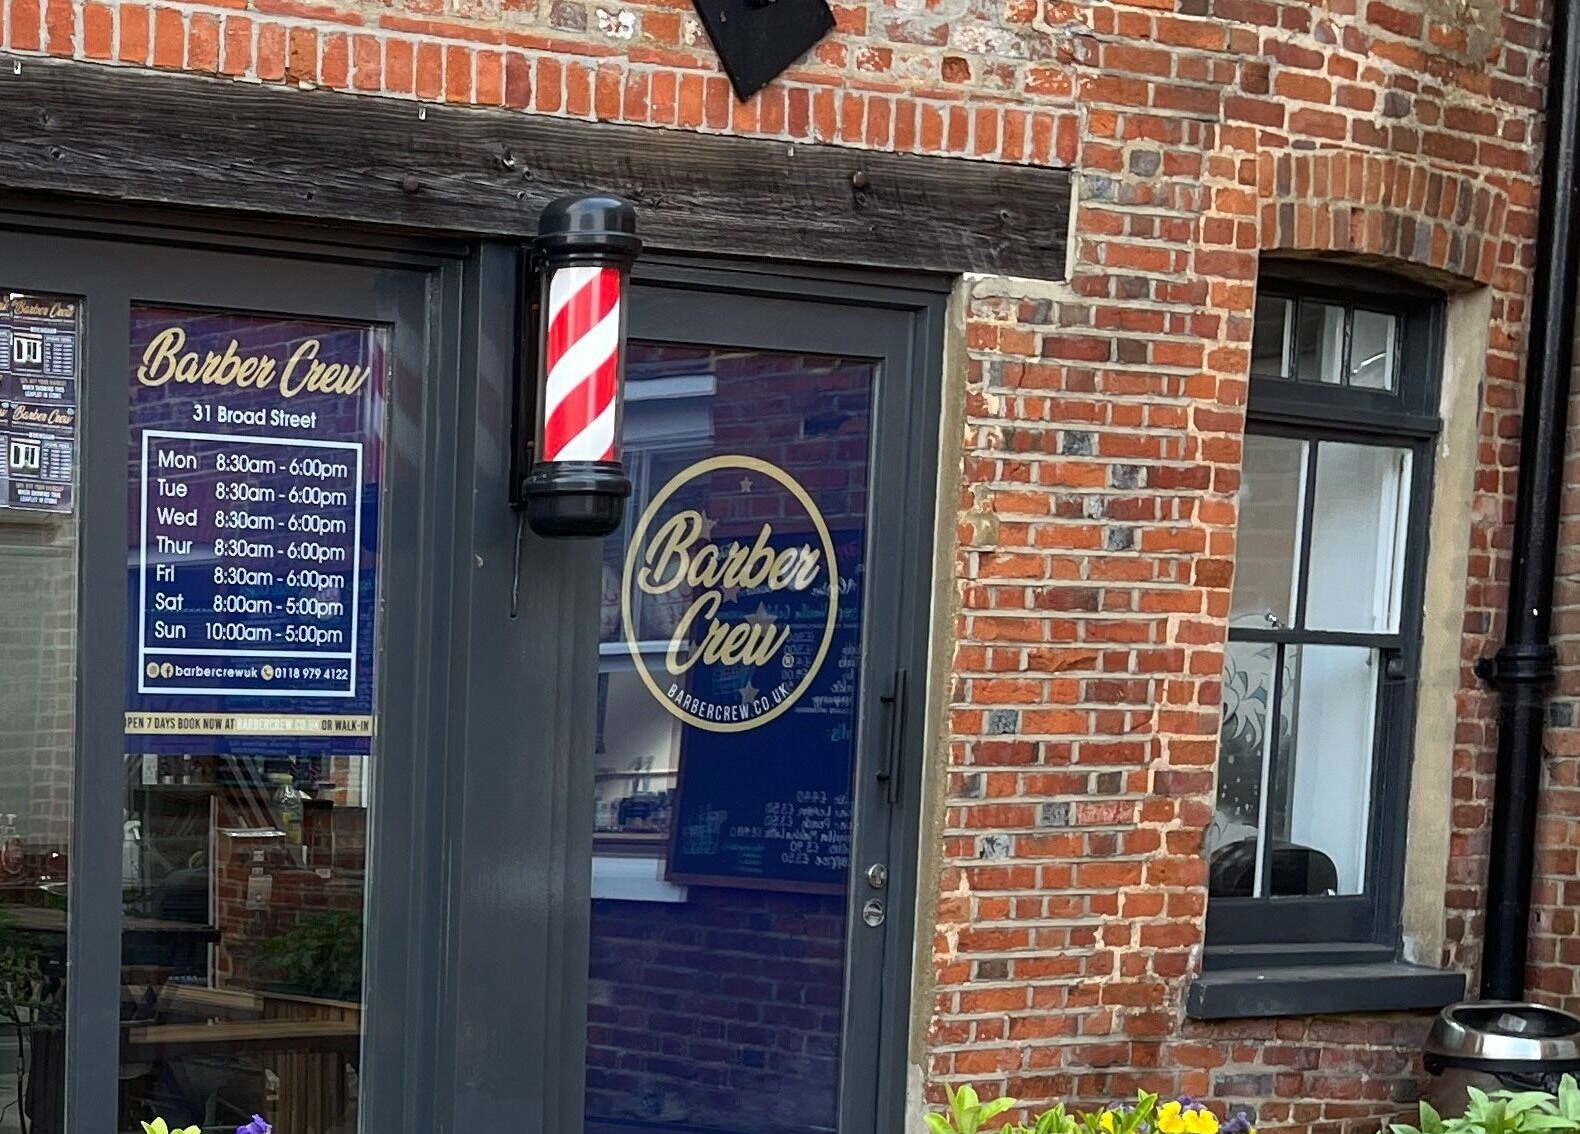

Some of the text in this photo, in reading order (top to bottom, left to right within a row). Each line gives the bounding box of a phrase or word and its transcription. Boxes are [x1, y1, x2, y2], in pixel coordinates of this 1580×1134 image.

[137, 327, 276, 388] Barber
[279, 339, 370, 398] Crew
[192, 404, 316, 428] 31 Broad Street
[158, 450, 197, 470] Mon
[216, 454, 276, 474] 8:30am
[289, 458, 348, 480] 6:00pm
[157, 478, 188, 498] Tue
[216, 482, 275, 502] 8:30am
[288, 486, 347, 508] 6:00pm
[156, 506, 198, 526] Wed
[214, 510, 274, 530] 8:30am
[288, 514, 346, 536] 6:00pm
[156, 535, 192, 554] Thur
[214, 538, 274, 558] 8:30am
[287, 542, 345, 563] 6:00pm
[638, 510, 820, 594] Barber
[156, 564, 174, 582] Fri
[214, 567, 272, 586] 8:30am
[286, 570, 344, 591] 6:00pm
[155, 593, 184, 611] Sat
[213, 595, 272, 614] 8:00am
[286, 598, 344, 618] 5:00pm
[154, 620, 186, 639] Sun
[206, 622, 271, 642] 10:00am
[285, 625, 342, 646] 5:00pm
[666, 590, 790, 676] Crew
[175, 666, 348, 680] barbercrewuk 0118 979 4122
[667, 683, 790, 720] BARBERCREW.CO.UK
[125, 717, 144, 728] PEN
[147, 717, 152, 728] 7
[154, 717, 175, 729] DAYS
[178, 718, 200, 729] BOOK
[203, 718, 222, 730] NOW
[225, 718, 234, 730] AT
[322, 720, 332, 730] OR
[335, 720, 369, 731] WALK-IN
